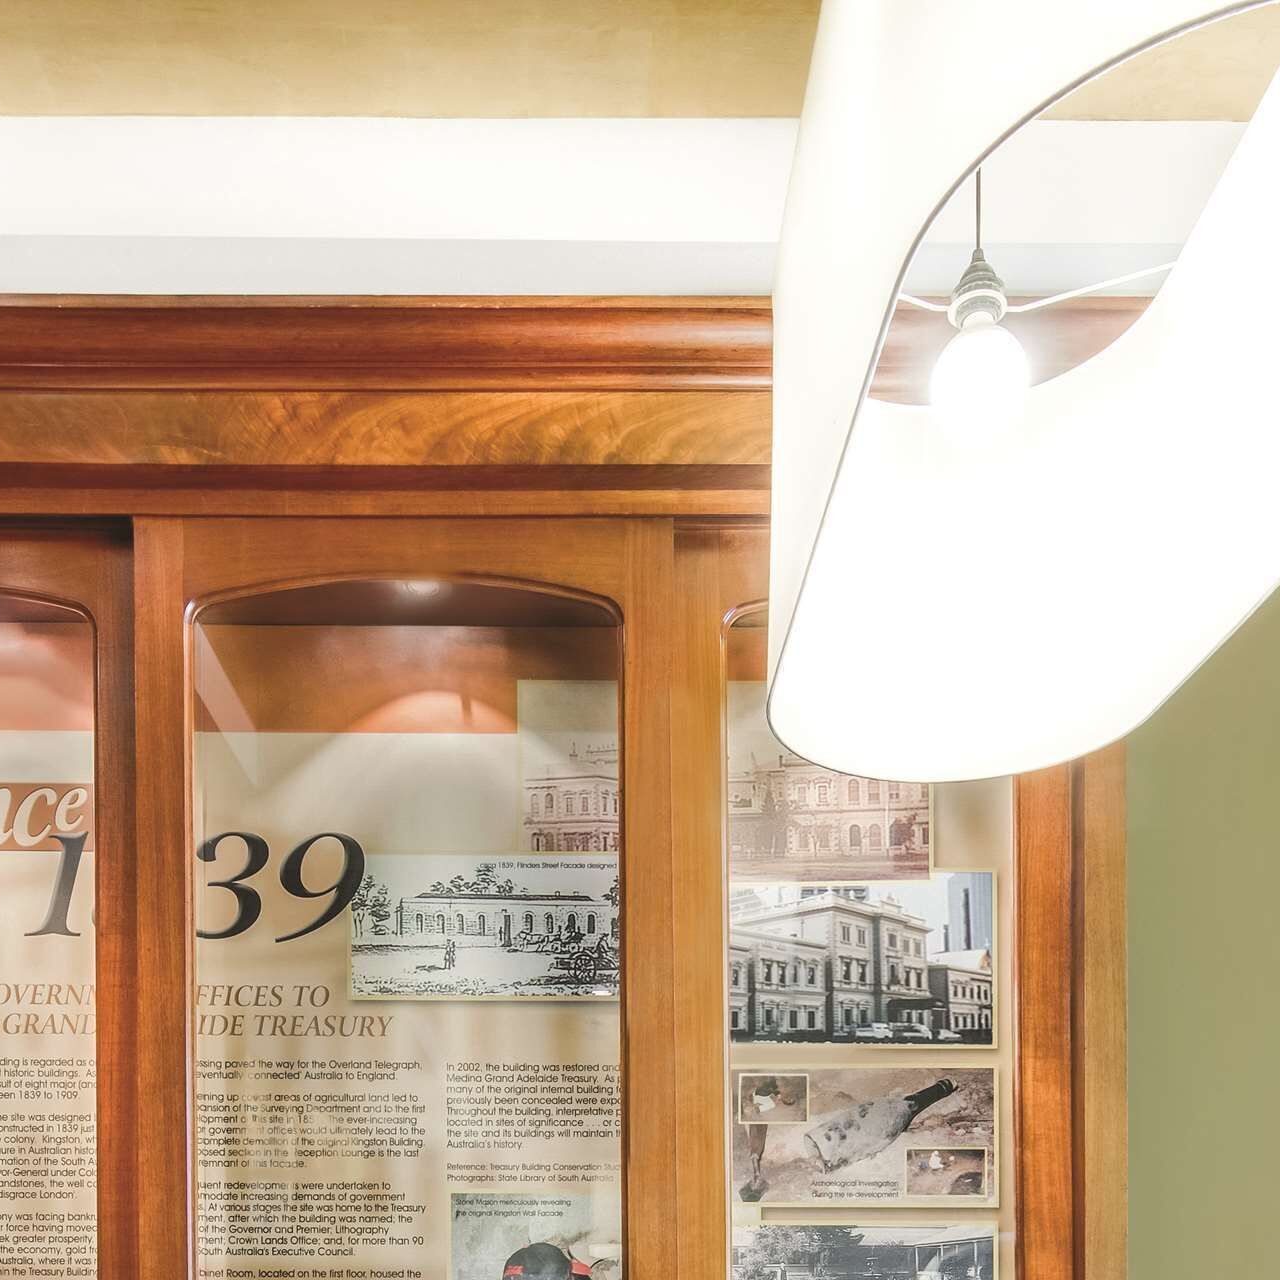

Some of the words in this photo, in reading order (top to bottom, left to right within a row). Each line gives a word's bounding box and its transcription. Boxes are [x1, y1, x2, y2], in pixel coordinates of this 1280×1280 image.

[293, 985, 330, 1008] TO
[3, 1012, 96, 1035] GRAND
[255, 1014, 394, 1037] TREASURY
[21, 1057, 29, 1066] is
[29, 1057, 74, 1068] regarded
[446, 1063, 454, 1072] In
[485, 1063, 500, 1072] the
[502, 1063, 540, 1073] building
[562, 1063, 599, 1072] restored
[304, 1072, 343, 1080] Australia
[345, 1072, 355, 1080] to
[446, 1074, 482, 1082] Medina
[484, 1074, 514, 1082] Grand
[516, 1074, 559, 1082] Adelaide
[604, 1074, 615, 1082] As
[13, 1079, 23, 1088] of
[24, 1079, 48, 1090] eight
[49, 1081, 76, 1090] major
[446, 1087, 473, 1095] many
[475, 1085, 484, 1094] of
[486, 1085, 501, 1094] the
[503, 1085, 538, 1095] original
[540, 1085, 574, 1094] internal
[576, 1085, 614, 1095] building
[19, 1091, 41, 1099] 1839
[43, 1091, 53, 1099] to
[446, 1097, 492, 1107] previously
[493, 1097, 519, 1105] been
[520, 1097, 573, 1105] concealed
[447, 1107, 496, 1117] Throughout
[498, 1107, 512, 1116] the
[555, 1107, 614, 1117] interpretative
[528, 1119, 584, 1128] significance
[446, 1130, 462, 1138] the
[463, 1130, 478, 1138] site
[481, 1130, 500, 1138] and
[502, 1130, 511, 1138] its
[513, 1130, 555, 1139] buildings
[557, 1130, 571, 1138] will
[572, 1130, 613, 1138] maintain
[445, 1140, 492, 1148] Australia's
[489, 1163, 520, 1172] Treasury
[521, 1163, 551, 1172] Building
[519, 1175, 546, 1183] Library
[35, 1211, 65, 1222] facing
[227, 1236, 259, 1244] Crown
[260, 1236, 288, 1244] Lands
[347, 1236, 361, 1244] for
[388, 1236, 410, 1244] than
[411, 1236, 425, 1244] 90
[225, 1248, 269, 1256] Australia's
[270, 1248, 315, 1256] Executive
[258, 1270, 295, 1278] located
[311, 1270, 327, 1278] the
[329, 1270, 344, 1278] first
[369, 1270, 404, 1278] housed
[406, 1270, 421, 1278] the
